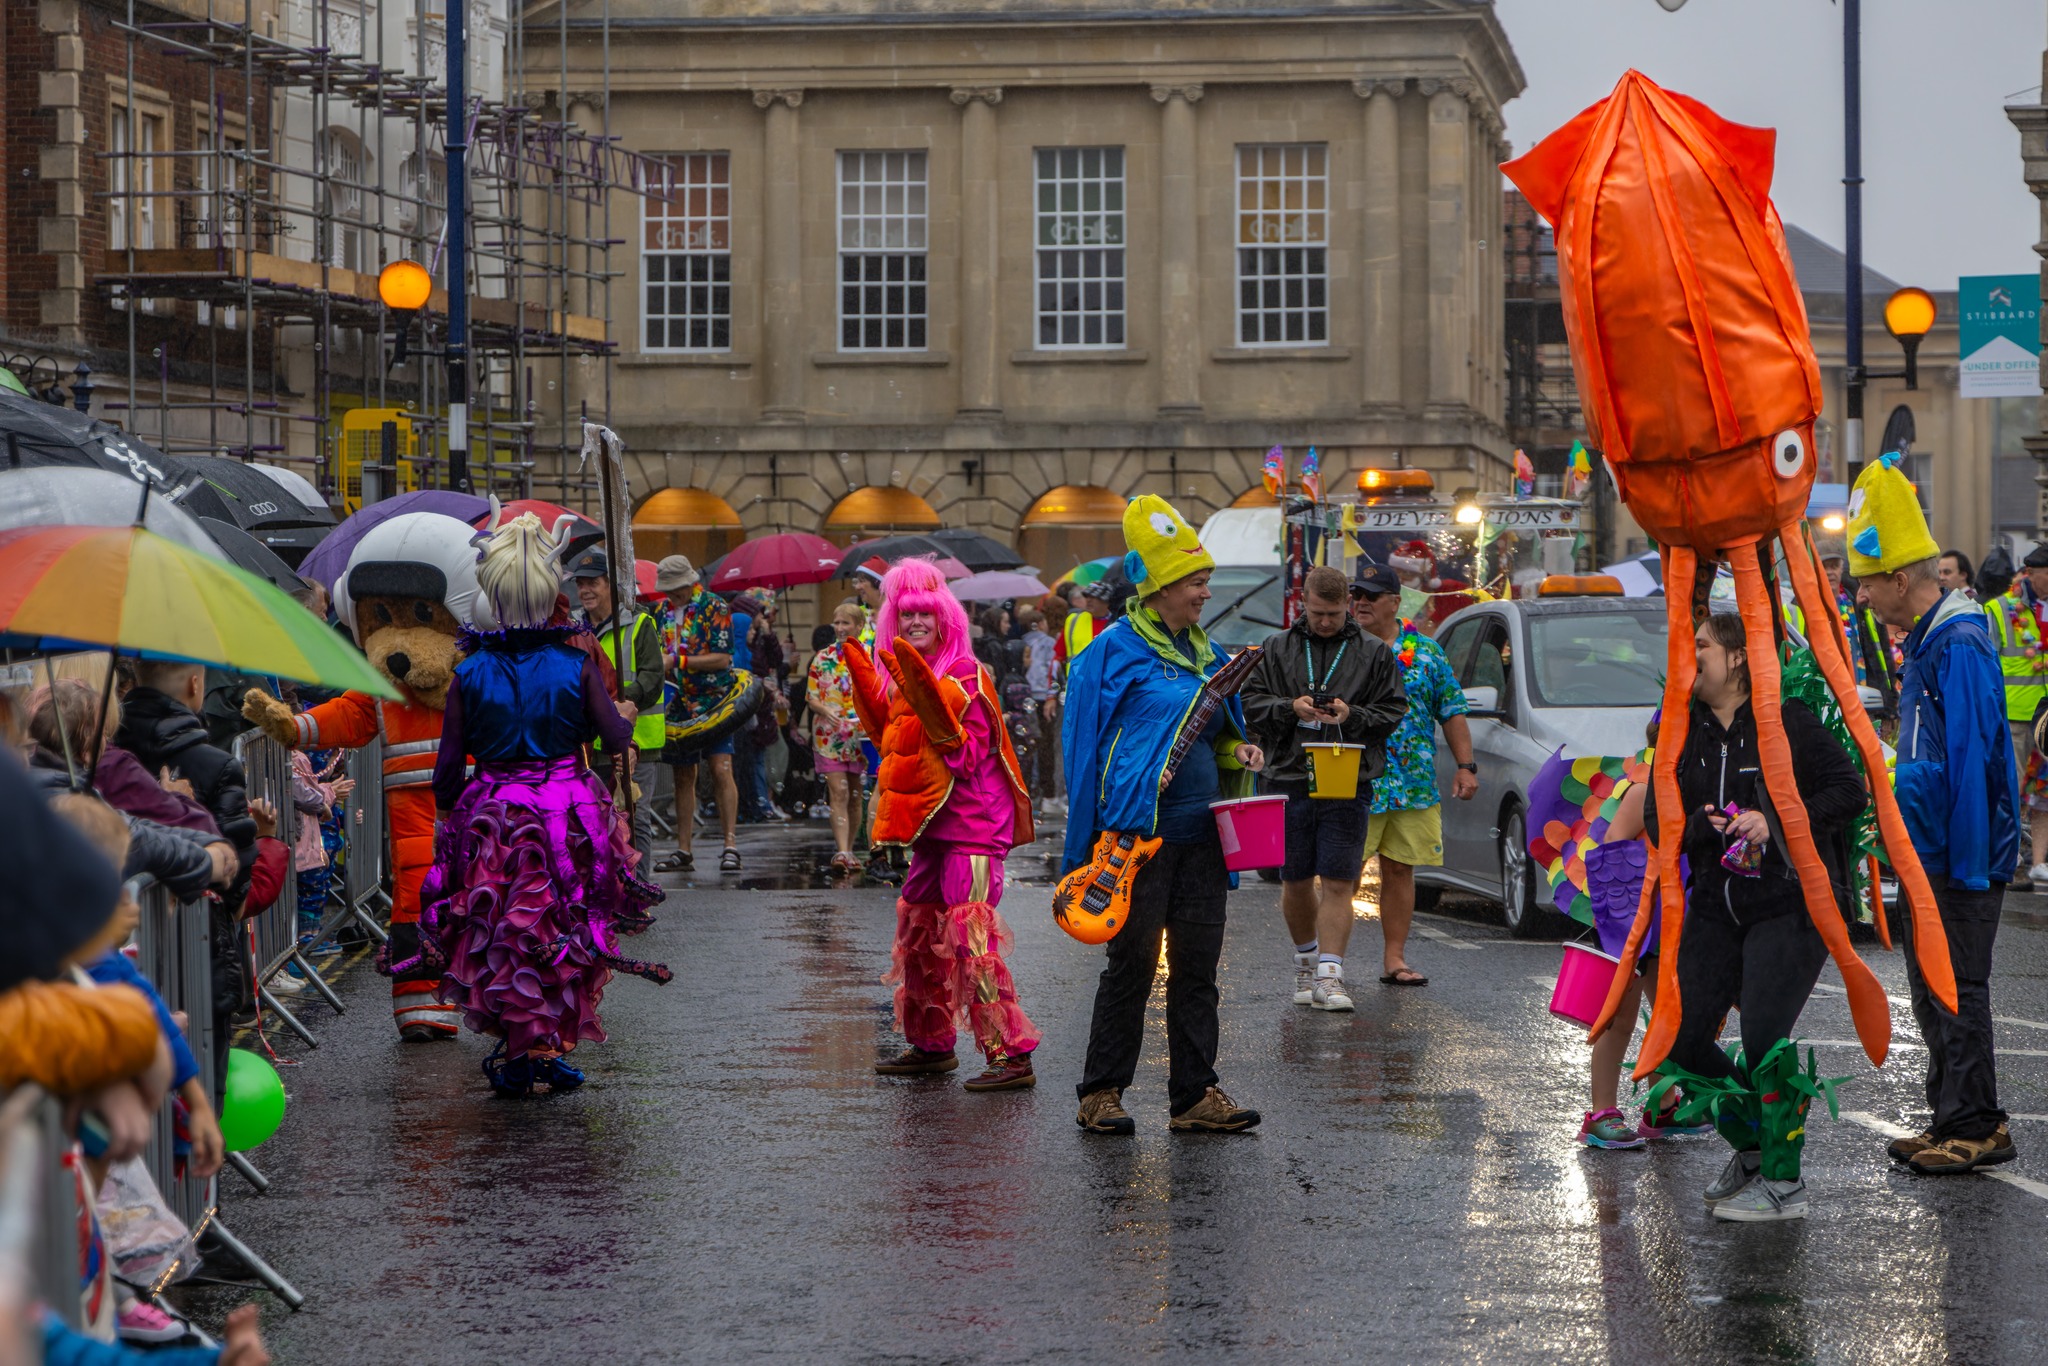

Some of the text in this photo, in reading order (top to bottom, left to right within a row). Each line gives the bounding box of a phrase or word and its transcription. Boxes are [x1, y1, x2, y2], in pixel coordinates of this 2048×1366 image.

[1966, 310, 2036, 320] STIBBARD
[1967, 360, 2037, 371] UNDER OFFER
